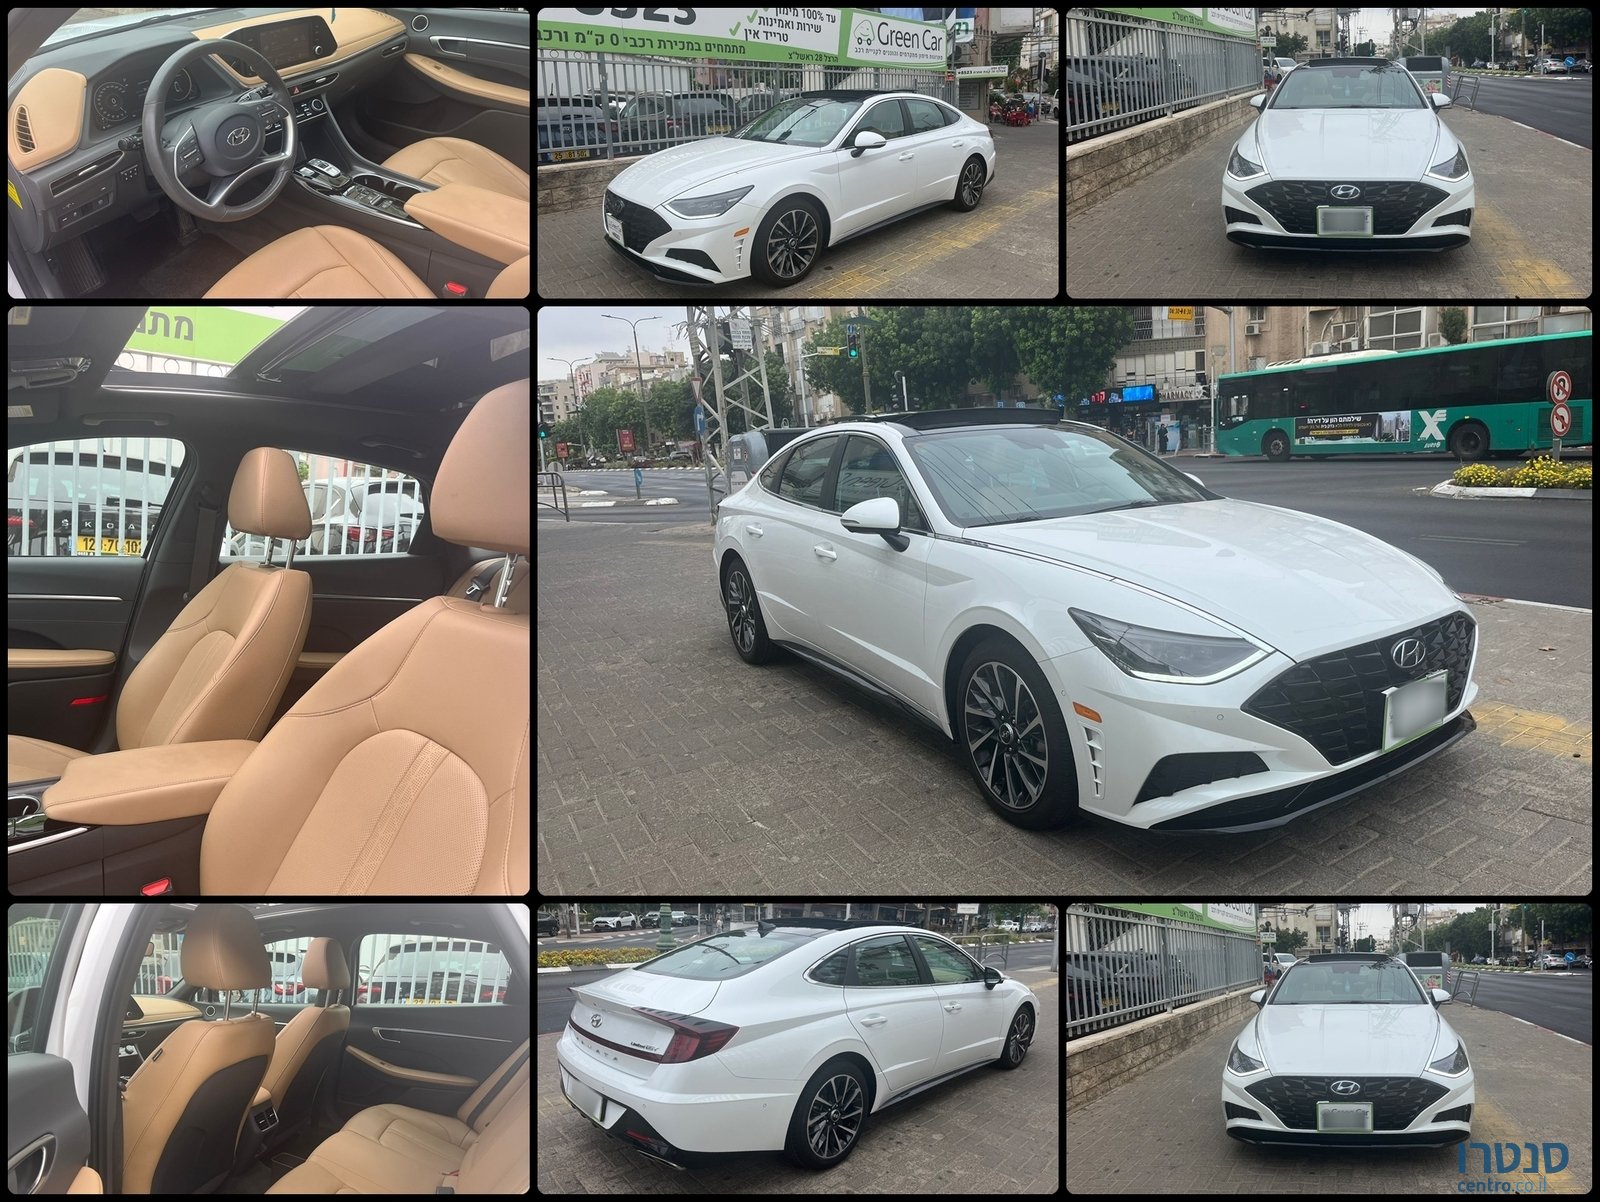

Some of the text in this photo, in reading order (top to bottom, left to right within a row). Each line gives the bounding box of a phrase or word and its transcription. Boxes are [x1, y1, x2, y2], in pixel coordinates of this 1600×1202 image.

[775, 8, 836, 23] עד 100% מימון
[758, 16, 822, 33] שירות ואמינות
[610, 33, 619, 46] 0
[623, 35, 654, 48] רכבי
[744, 28, 789, 42] טרייד אין
[877, 22, 943, 51] Green Car
[658, 38, 702, 52] במכירת
[705, 41, 746, 54] מתמחים
[814, 54, 823, 62] 28
[823, 55, 839, 63] הרצל
